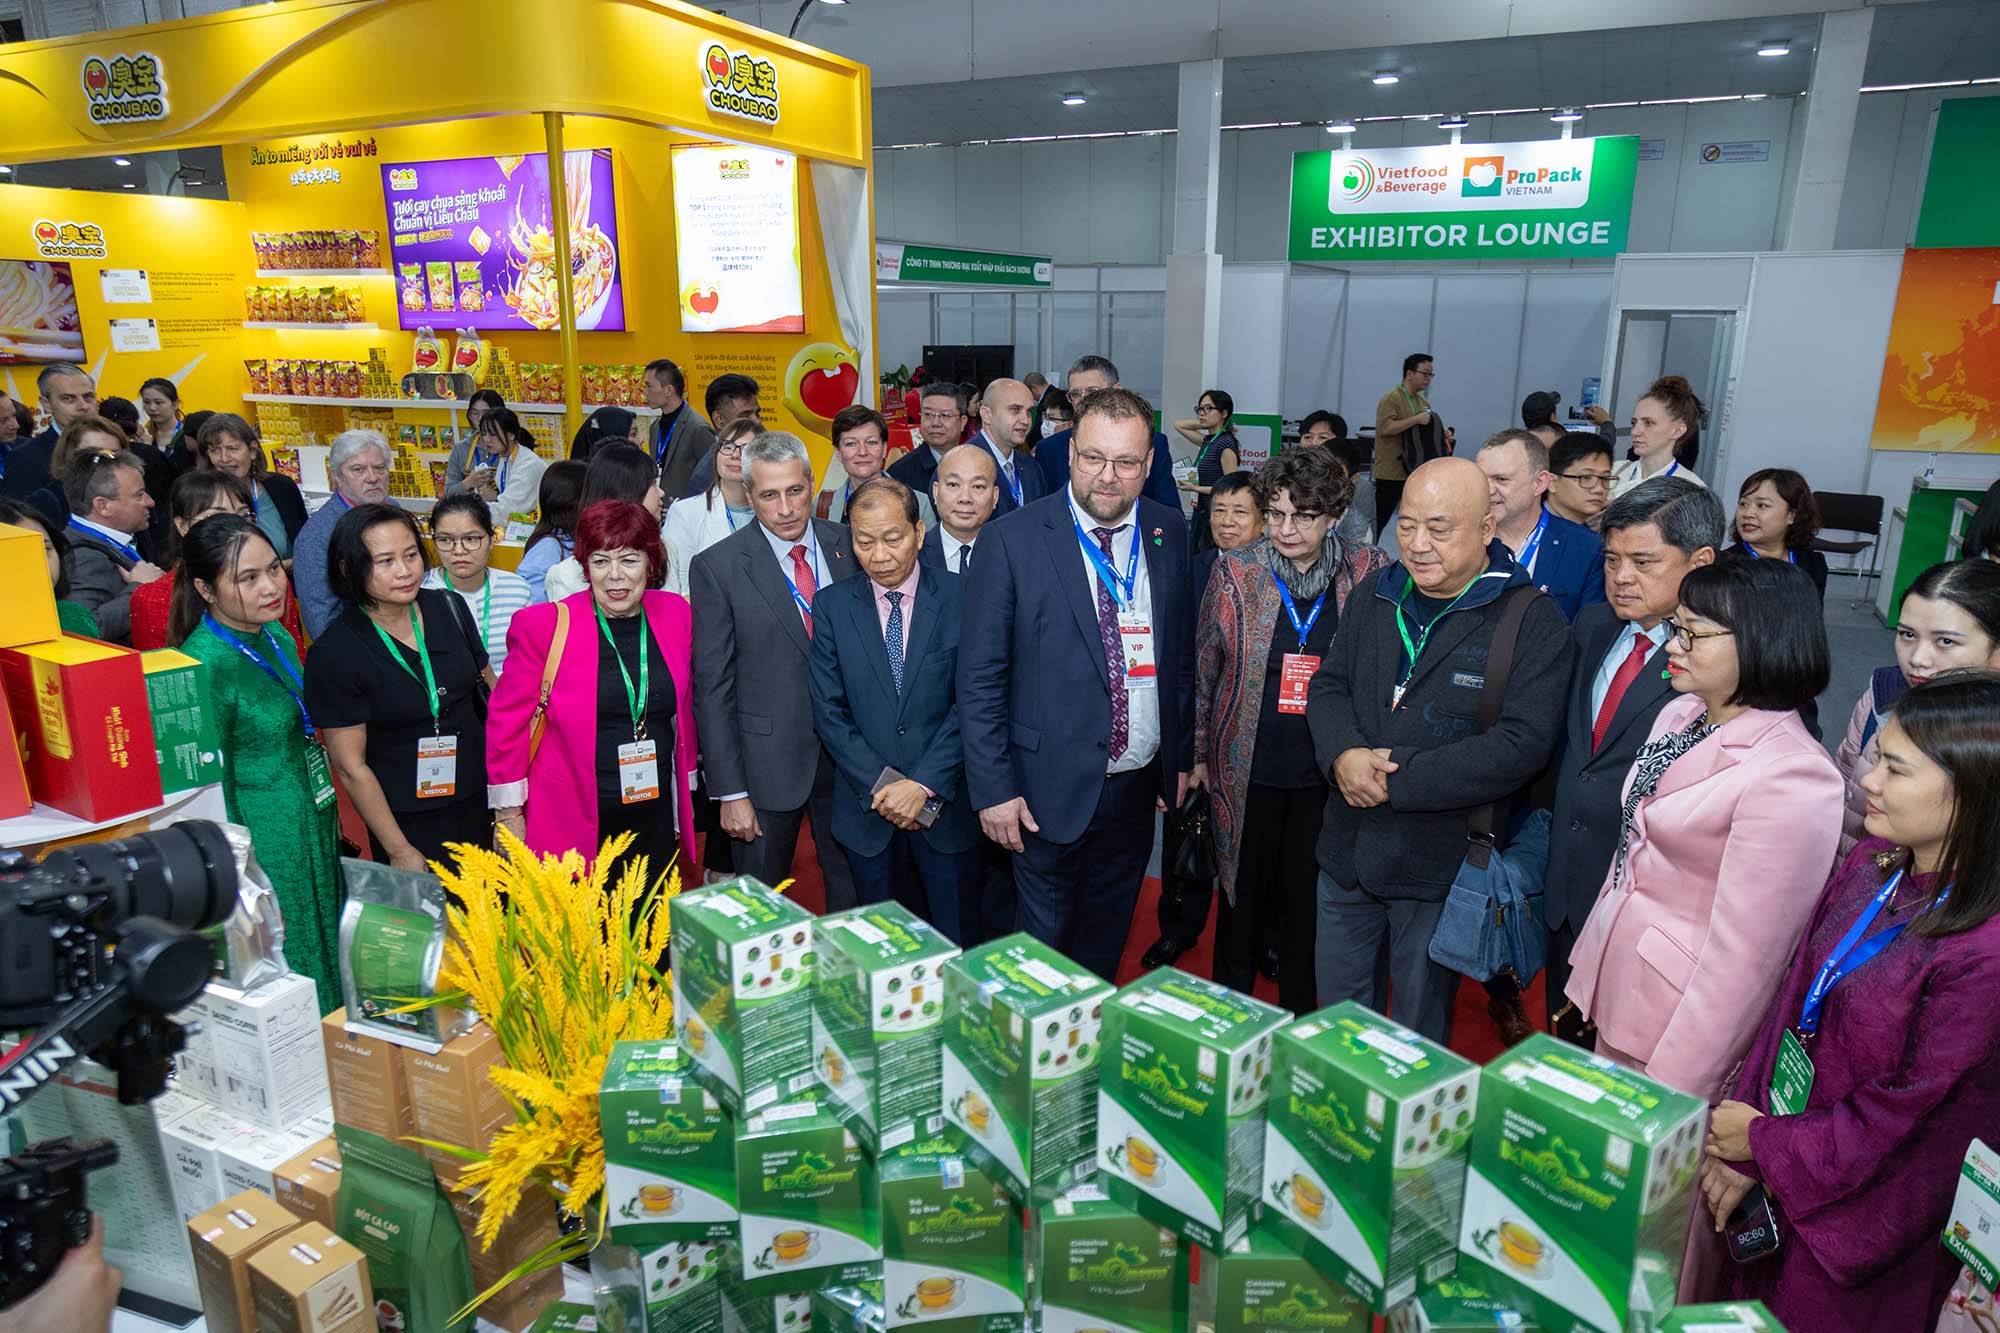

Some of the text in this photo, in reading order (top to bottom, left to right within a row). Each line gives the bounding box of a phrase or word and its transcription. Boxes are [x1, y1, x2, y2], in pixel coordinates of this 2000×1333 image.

[91, 99, 163, 120] CHOUBAO
[710, 89, 778, 120] CHOUBAO
[1377, 164, 1448, 182] Vietfood
[1507, 167, 1583, 186] ProPack
[1506, 186, 1553, 197] VIETNAM
[1311, 221, 1611, 248] EXHIBITOR LOUNGE
[41, 246, 105, 257] CHOUBAO
[906, 256, 922, 268] CÔNG
[922, 260, 929, 268] TY
[1131, 643, 1144, 652] VIP
[628, 791, 652, 800] VISITOR
[1737, 1227, 1765, 1244] 09:26
[1949, 1237, 1994, 1285] EXHIBITOR
